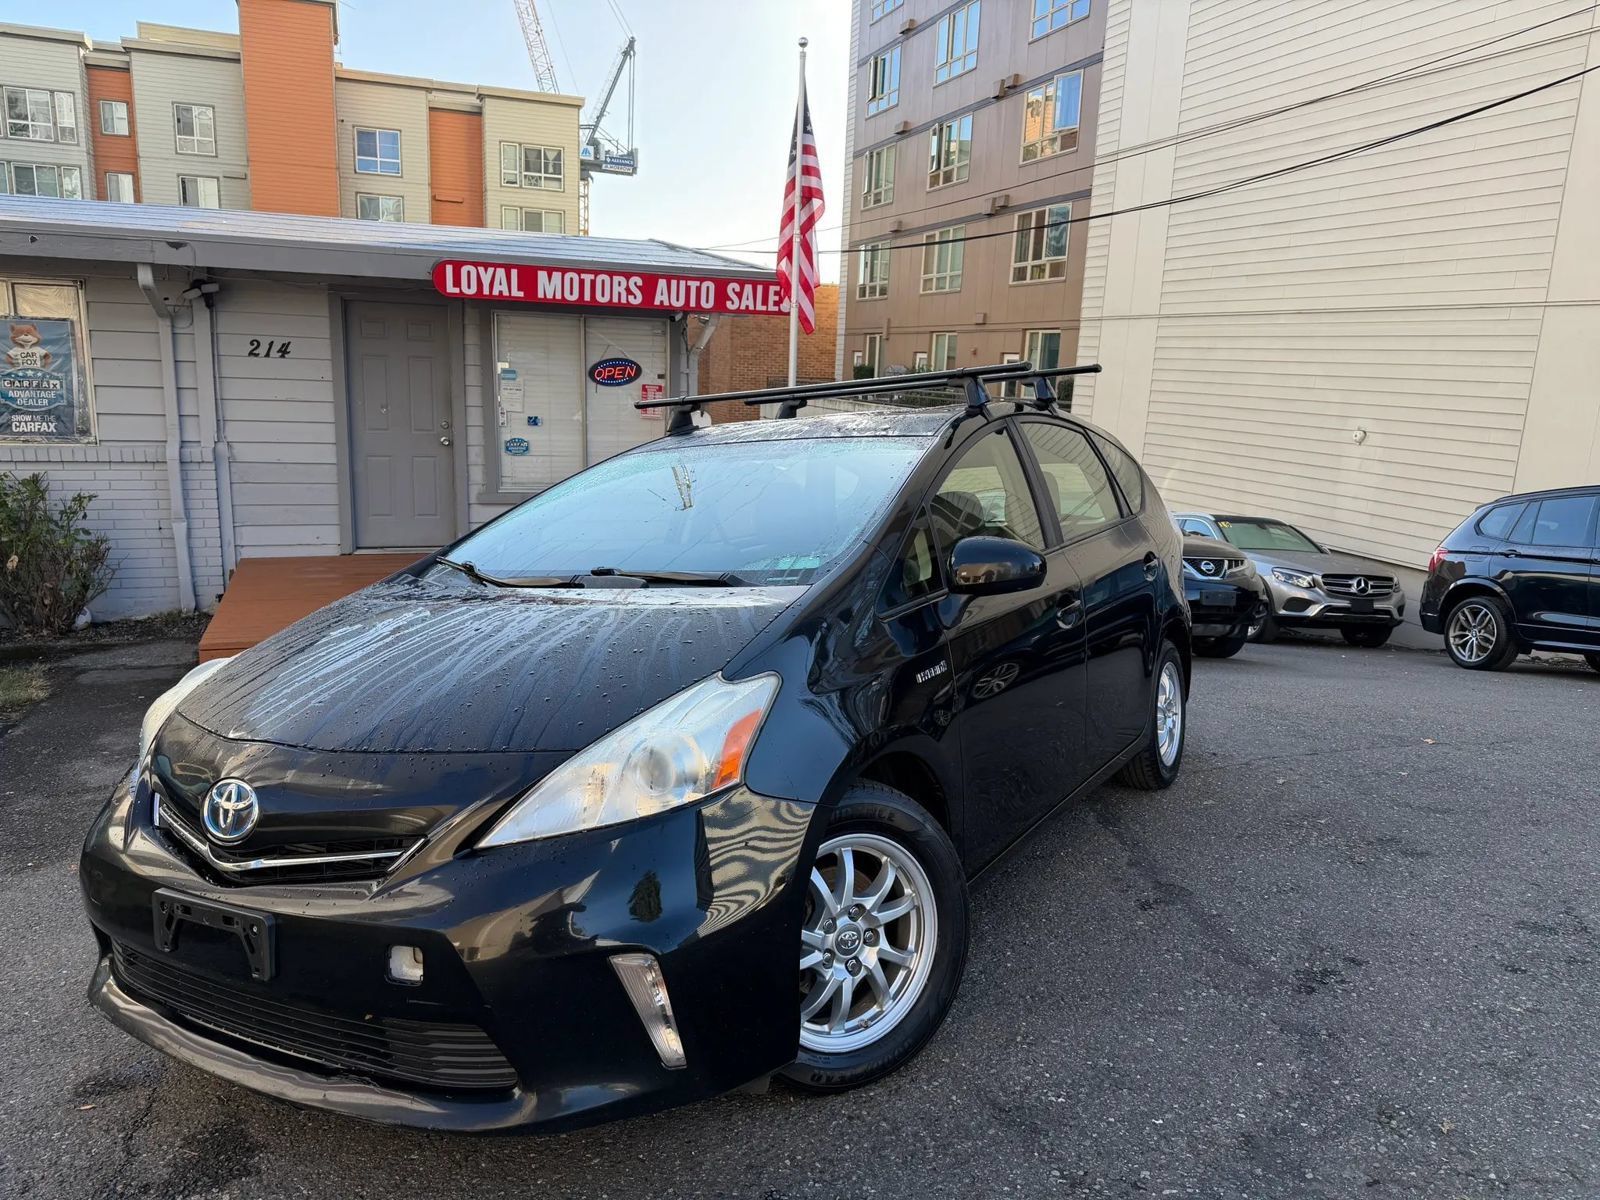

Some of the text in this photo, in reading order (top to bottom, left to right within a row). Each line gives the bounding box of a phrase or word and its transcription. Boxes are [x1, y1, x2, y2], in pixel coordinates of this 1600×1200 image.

[445, 264, 524, 297] LOYAL
[537, 270, 643, 305] MOTORS
[654, 278, 715, 309] AUTO
[248, 339, 291, 358] 214
[20, 351, 38, 359] CAR
[21, 358, 38, 366] FOX
[594, 366, 637, 380] OPEN
[4, 380, 58, 389] CARFAX
[8, 390, 56, 399] ADVANTAGE
[17, 398, 49, 406] DEALER
[11, 414, 32, 422] SHOW
[12, 421, 57, 433] CARFAX
